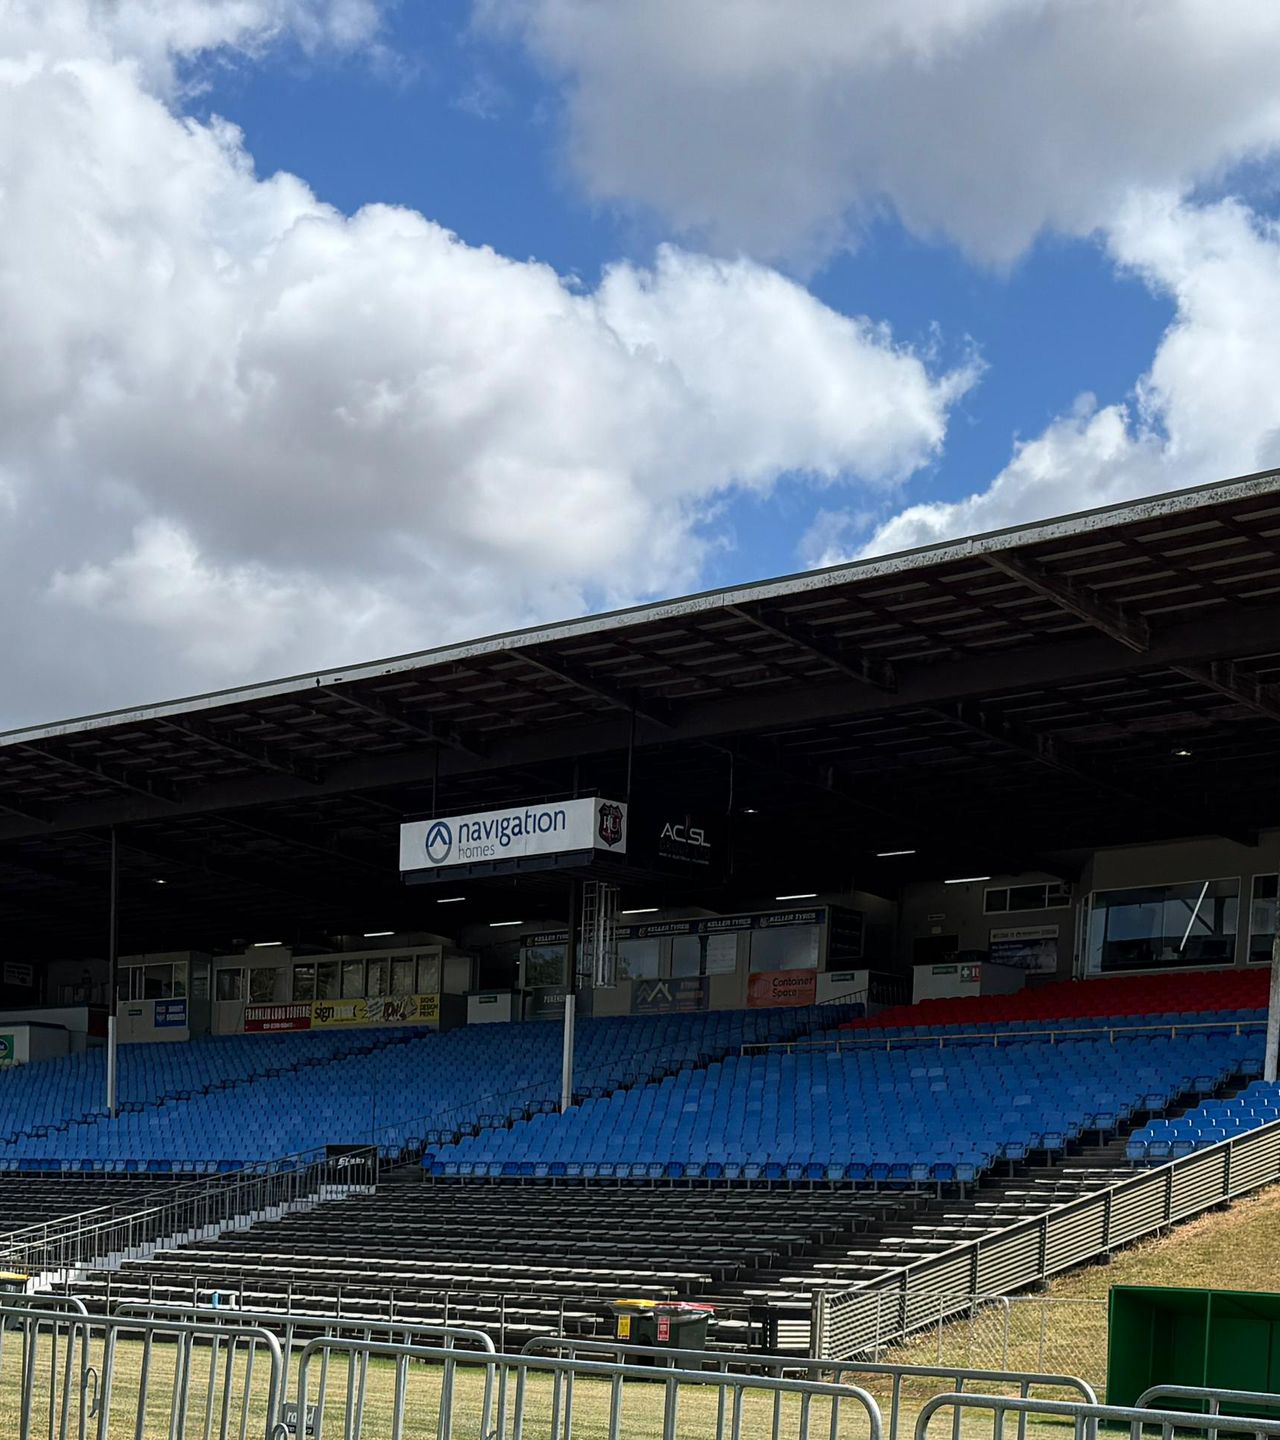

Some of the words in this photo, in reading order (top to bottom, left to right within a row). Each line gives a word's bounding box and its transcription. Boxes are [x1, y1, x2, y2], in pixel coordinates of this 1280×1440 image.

[459, 810, 566, 847] navigation
[459, 844, 495, 860] homes
[772, 977, 814, 987] Container
[772, 988, 797, 998] Space
[287, 1407, 315, 1424] rad
